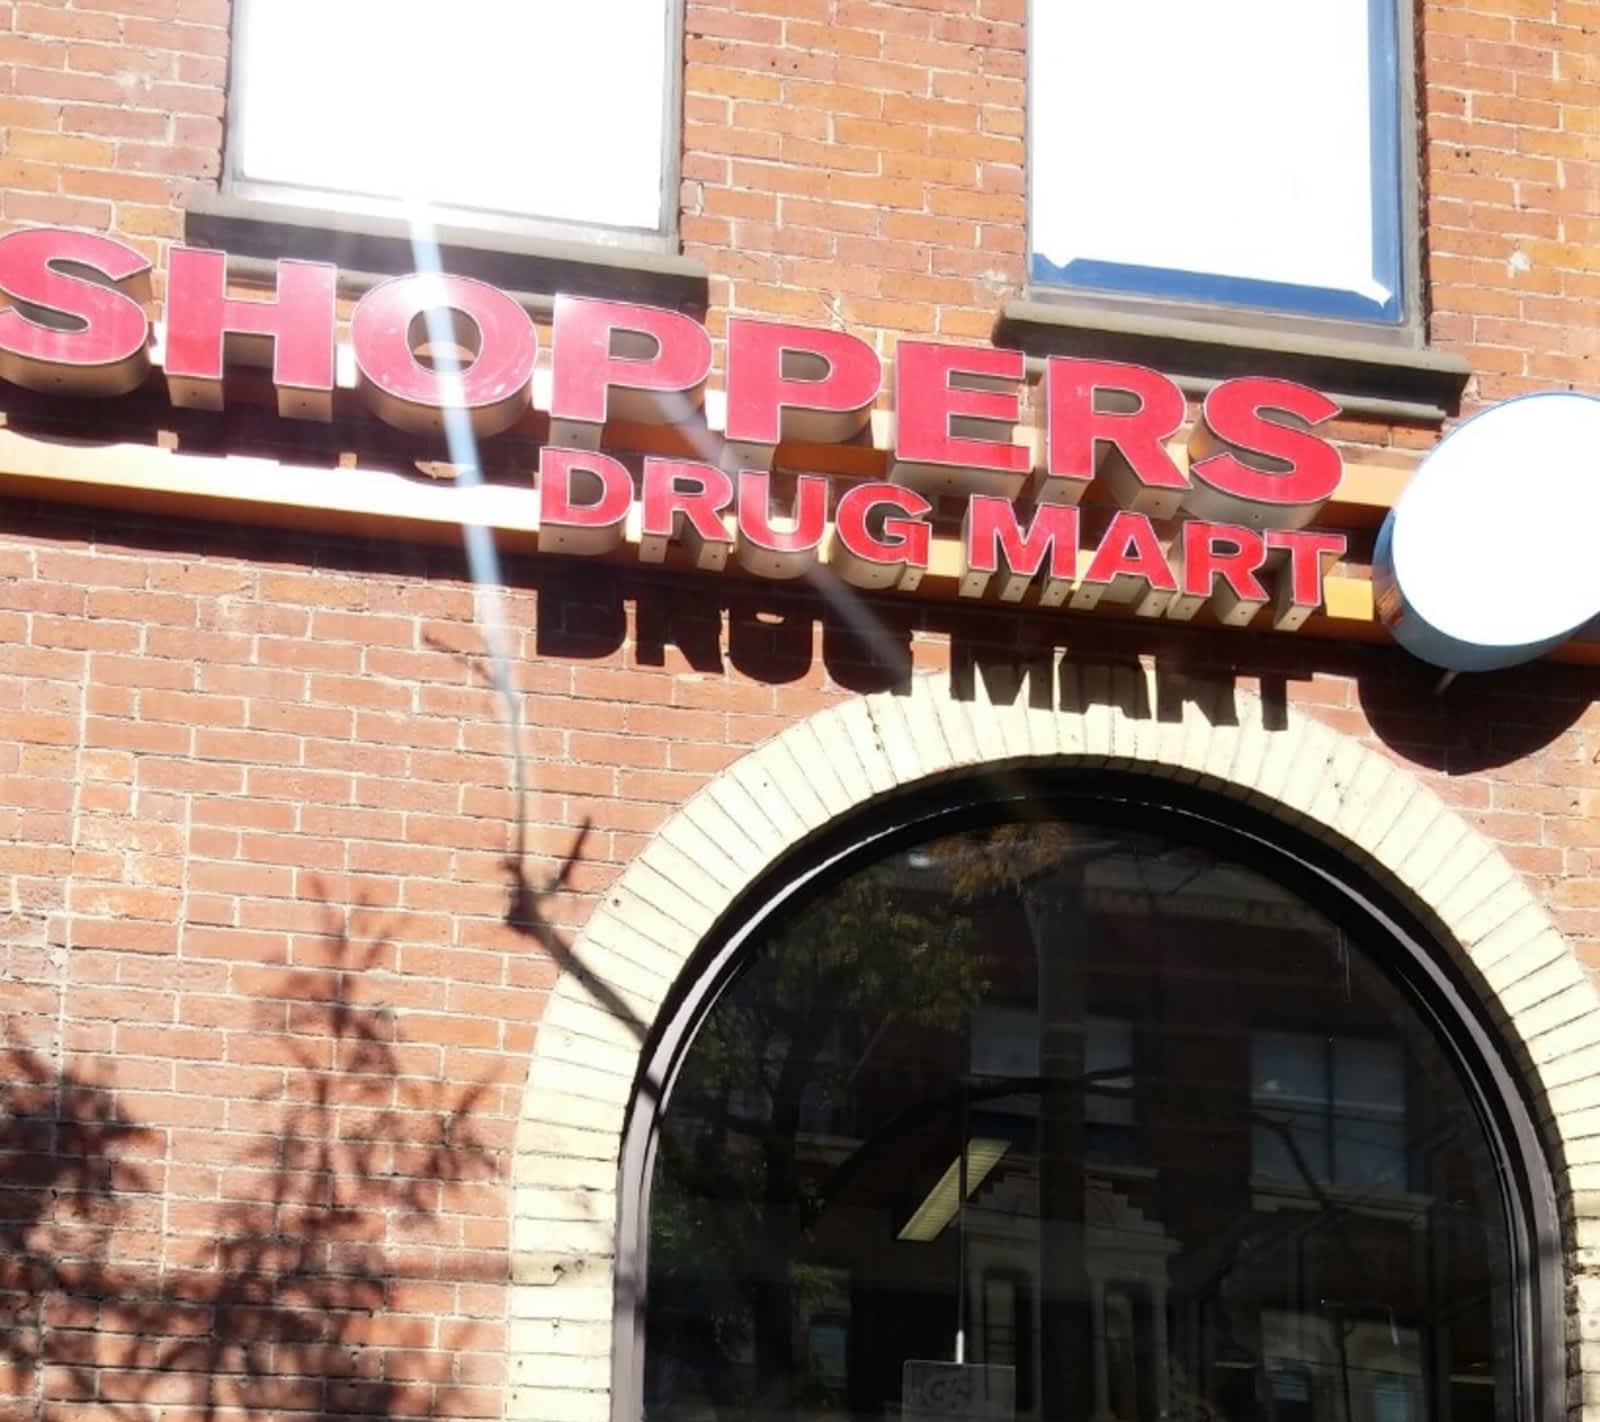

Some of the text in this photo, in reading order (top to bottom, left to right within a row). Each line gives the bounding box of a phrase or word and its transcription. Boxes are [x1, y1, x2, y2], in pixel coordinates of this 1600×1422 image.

[0, 228, 1344, 506] SHOPPERS
[539, 447, 1348, 607] DRUG MART
